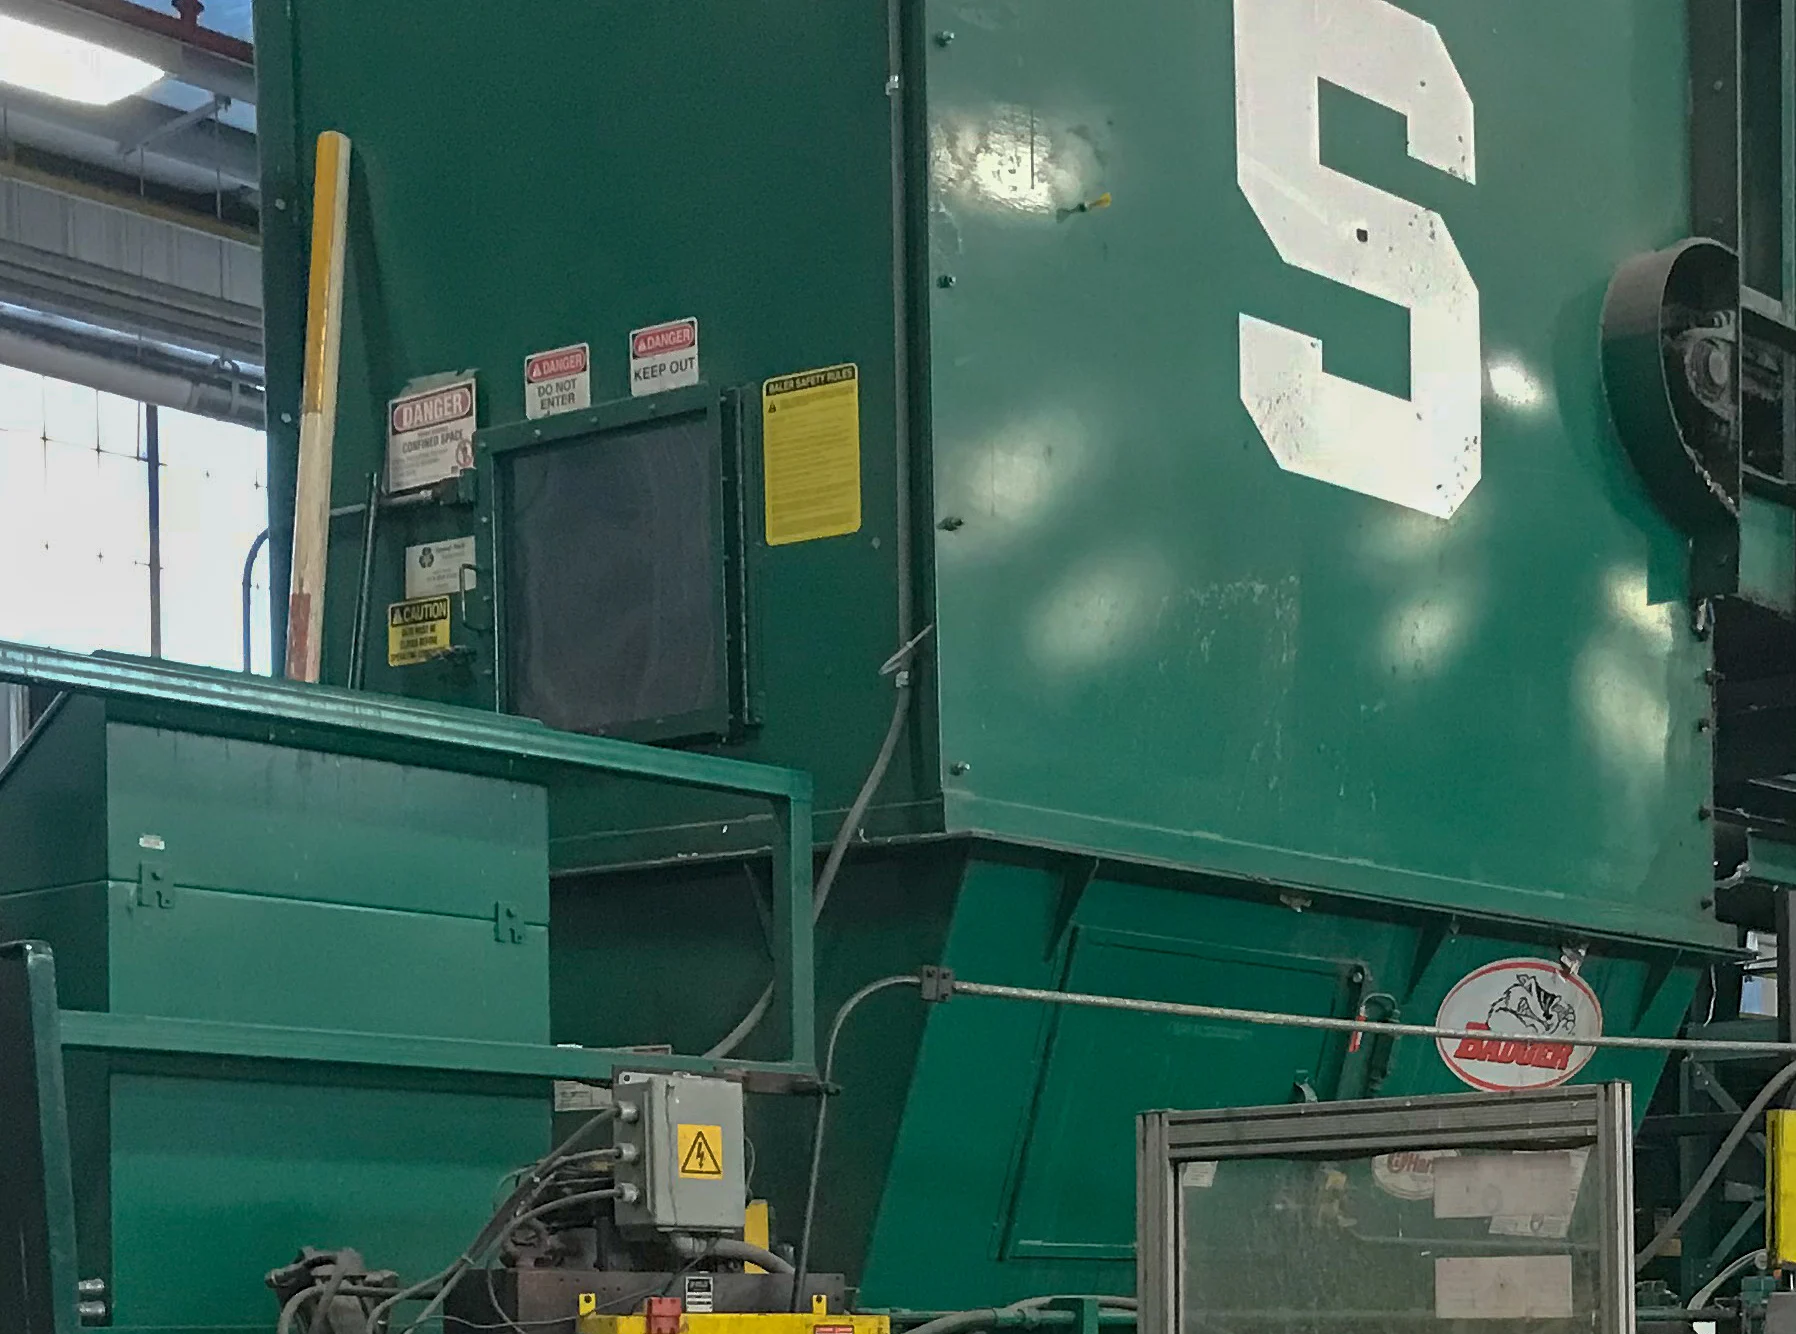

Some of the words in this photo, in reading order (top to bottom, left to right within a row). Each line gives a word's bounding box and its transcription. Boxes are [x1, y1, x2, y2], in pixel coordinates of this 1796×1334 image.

[1234, 0, 1481, 520] S
[647, 329, 690, 350] DANGER
[543, 353, 583, 375] DANGER
[634, 363, 666, 382] KEEP
[670, 357, 695, 374] OUT
[538, 383, 553, 398] DO
[556, 378, 577, 392] NOT
[795, 373, 826, 389] SAFETY
[827, 368, 853, 382] RULES
[402, 392, 464, 428] DANGER
[540, 392, 576, 410] ENTER
[402, 434, 440, 455] CONFINED
[403, 602, 447, 621] CAUTION
